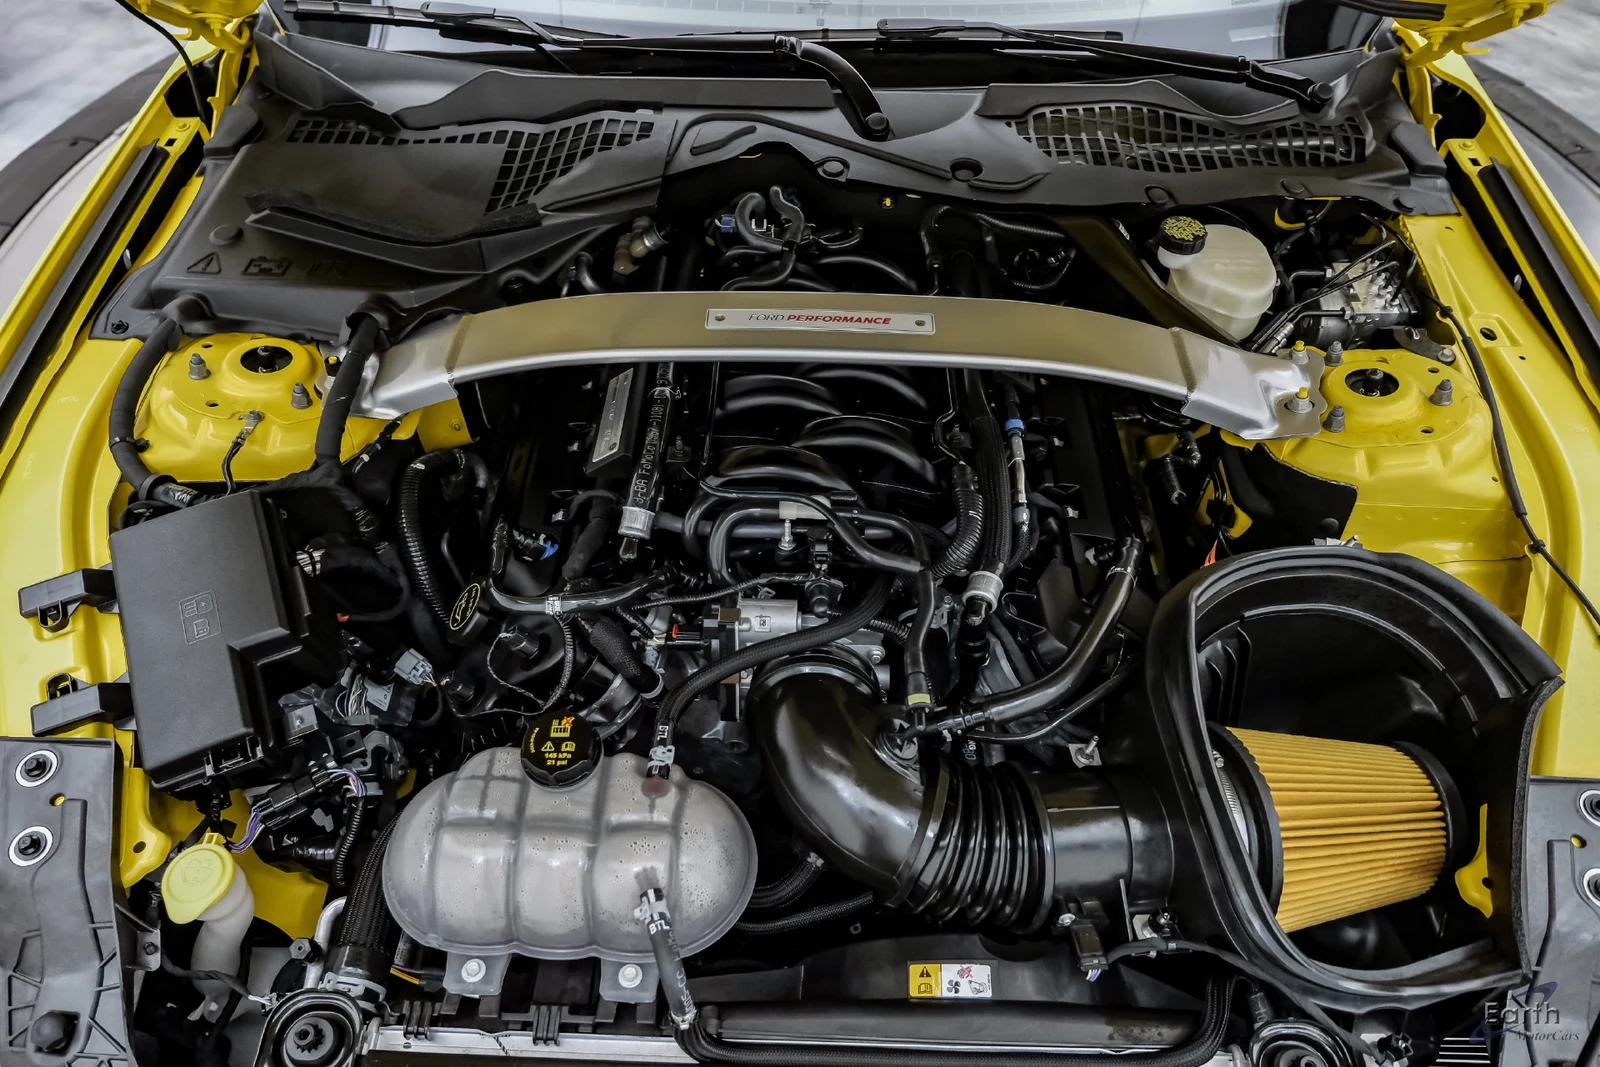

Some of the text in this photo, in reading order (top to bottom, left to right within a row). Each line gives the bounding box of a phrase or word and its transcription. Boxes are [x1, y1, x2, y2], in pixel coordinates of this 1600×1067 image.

[748, 313, 892, 325] FORD PERFORMANCE
[648, 919, 670, 935] BTL
